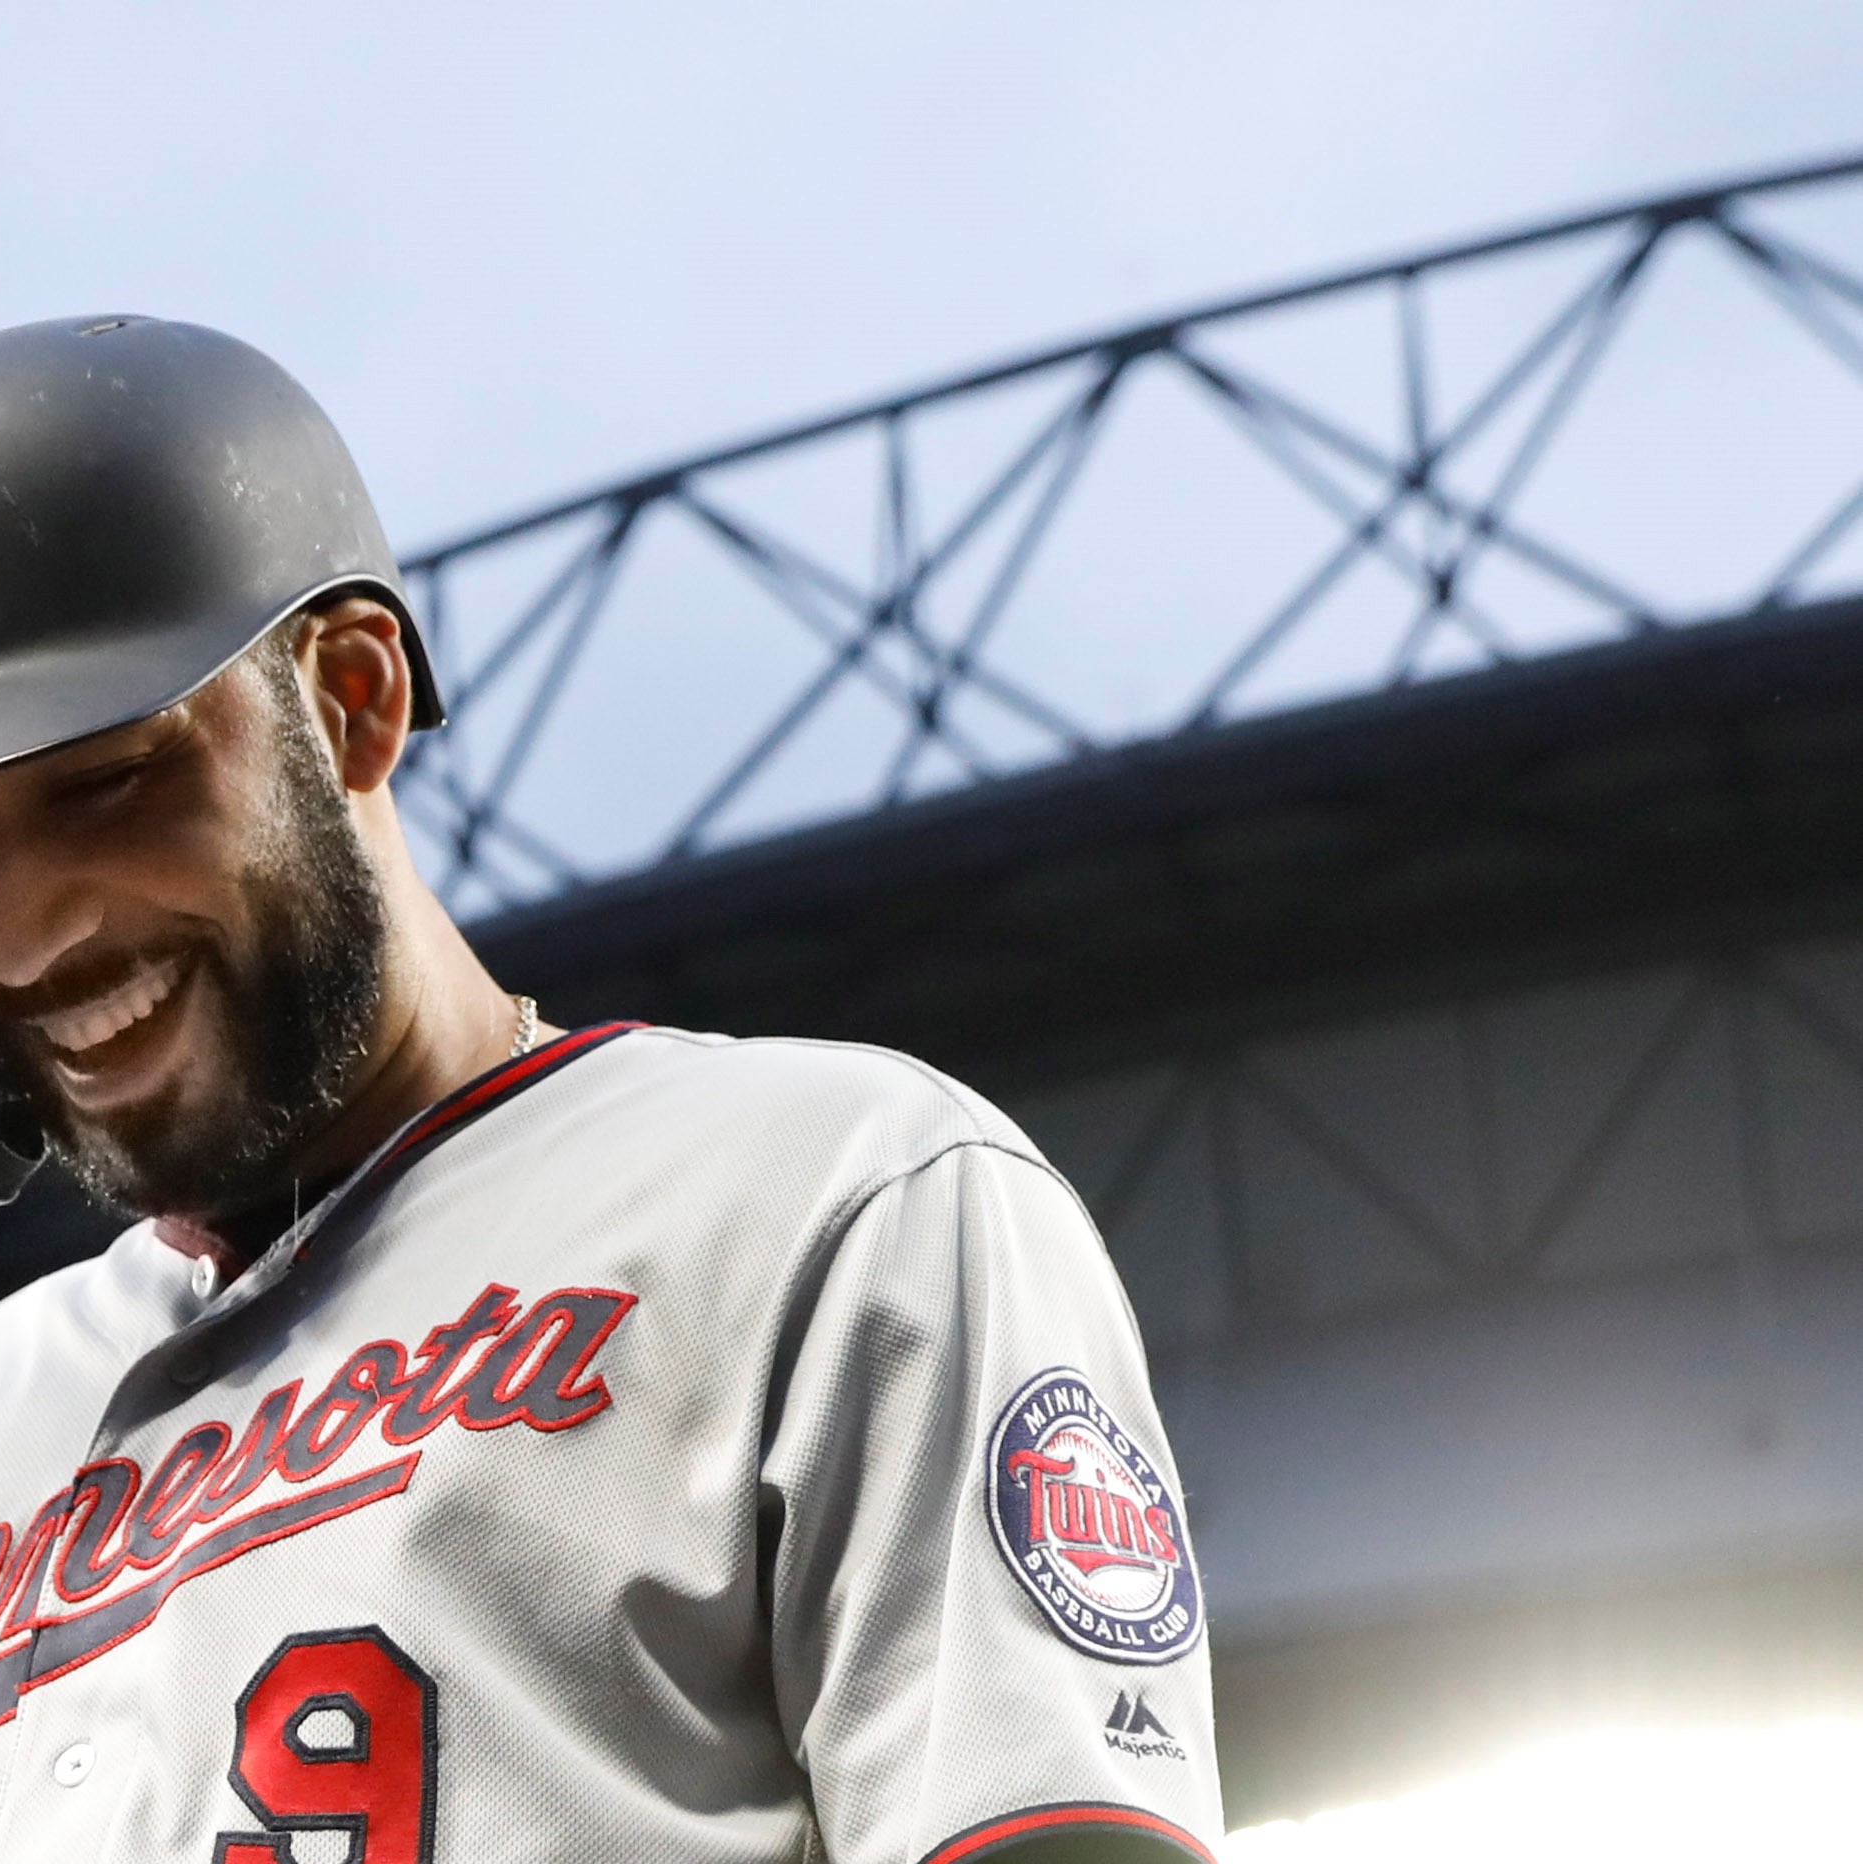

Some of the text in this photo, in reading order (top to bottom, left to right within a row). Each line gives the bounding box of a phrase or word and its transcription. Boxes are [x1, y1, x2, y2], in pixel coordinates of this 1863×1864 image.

[1024, 1387, 1163, 1507] MINNESOTA
[1008, 1449, 1180, 1570] Twins
[1025, 1551, 1189, 1646] BASEBALL CLUB
[1104, 1733, 1186, 1761] Majestic
